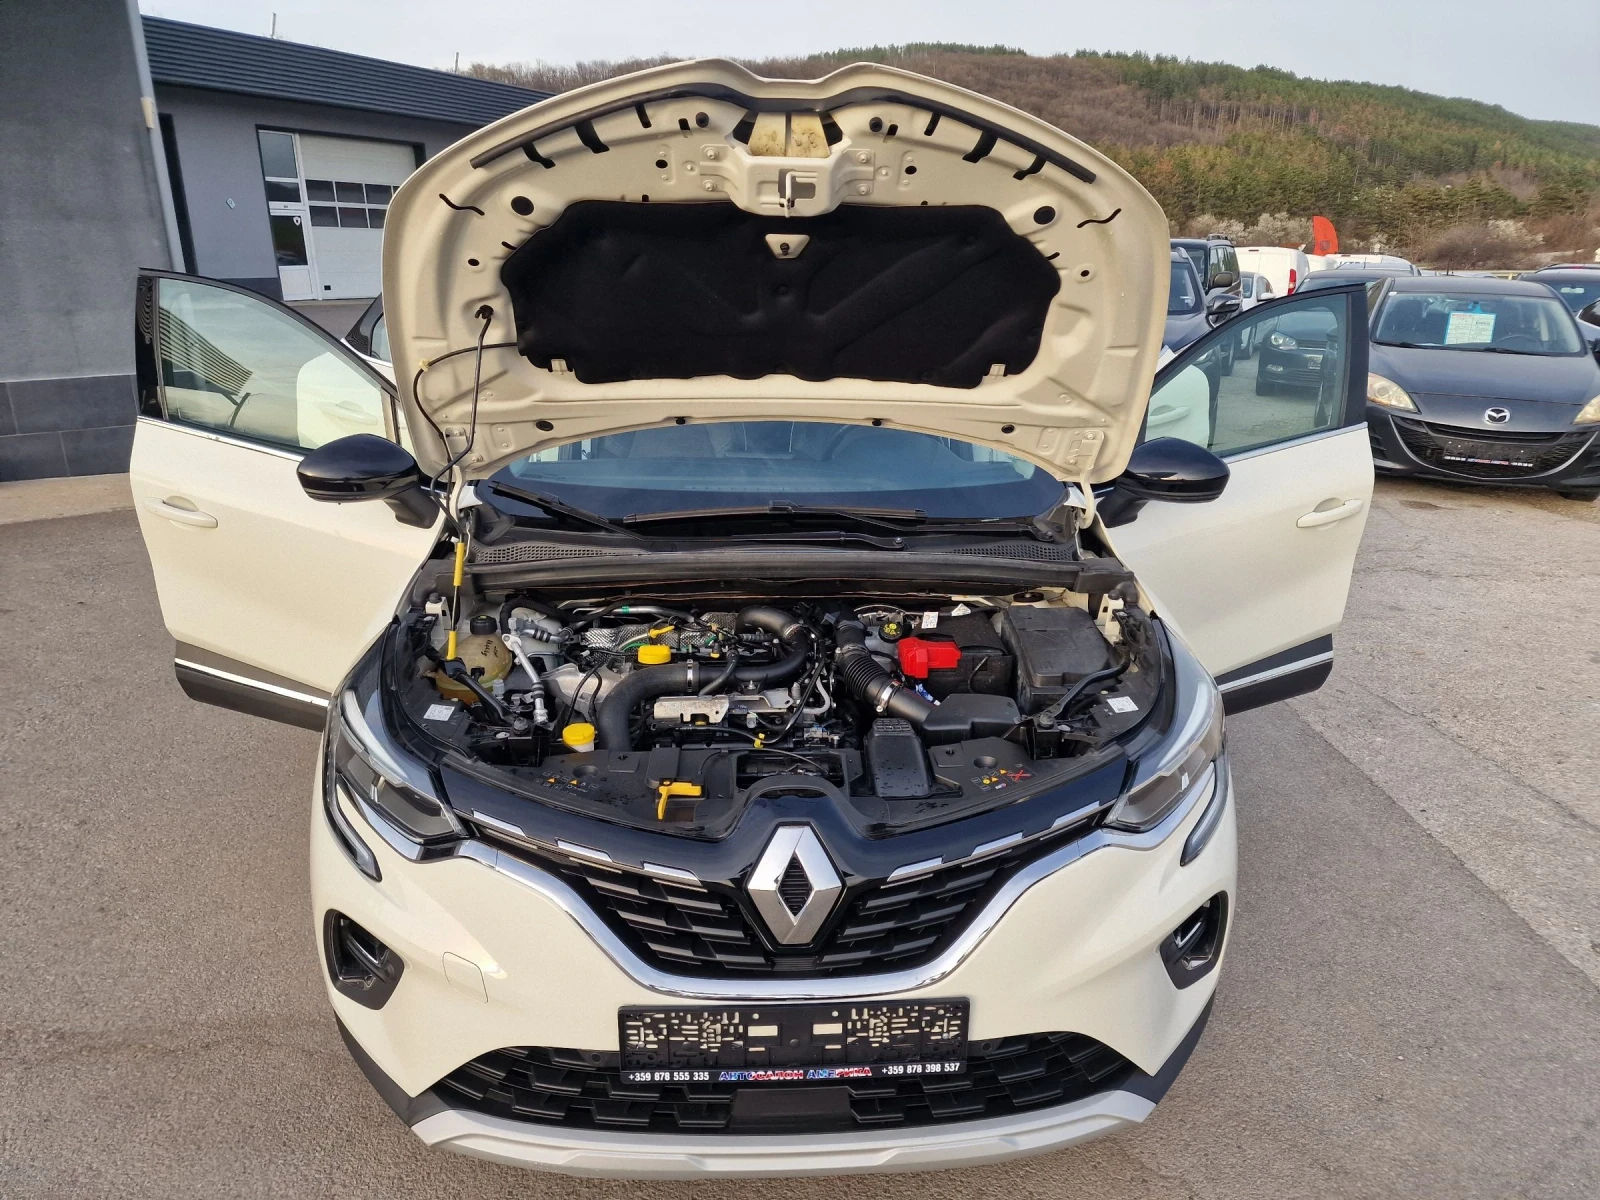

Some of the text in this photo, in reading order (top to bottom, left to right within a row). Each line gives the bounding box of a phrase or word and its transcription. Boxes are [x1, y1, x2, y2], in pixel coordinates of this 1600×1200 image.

[629, 1062, 960, 1081] +359 878 555 335 АВТОСАЛОН АМЕРИКА +359 878 398 537
